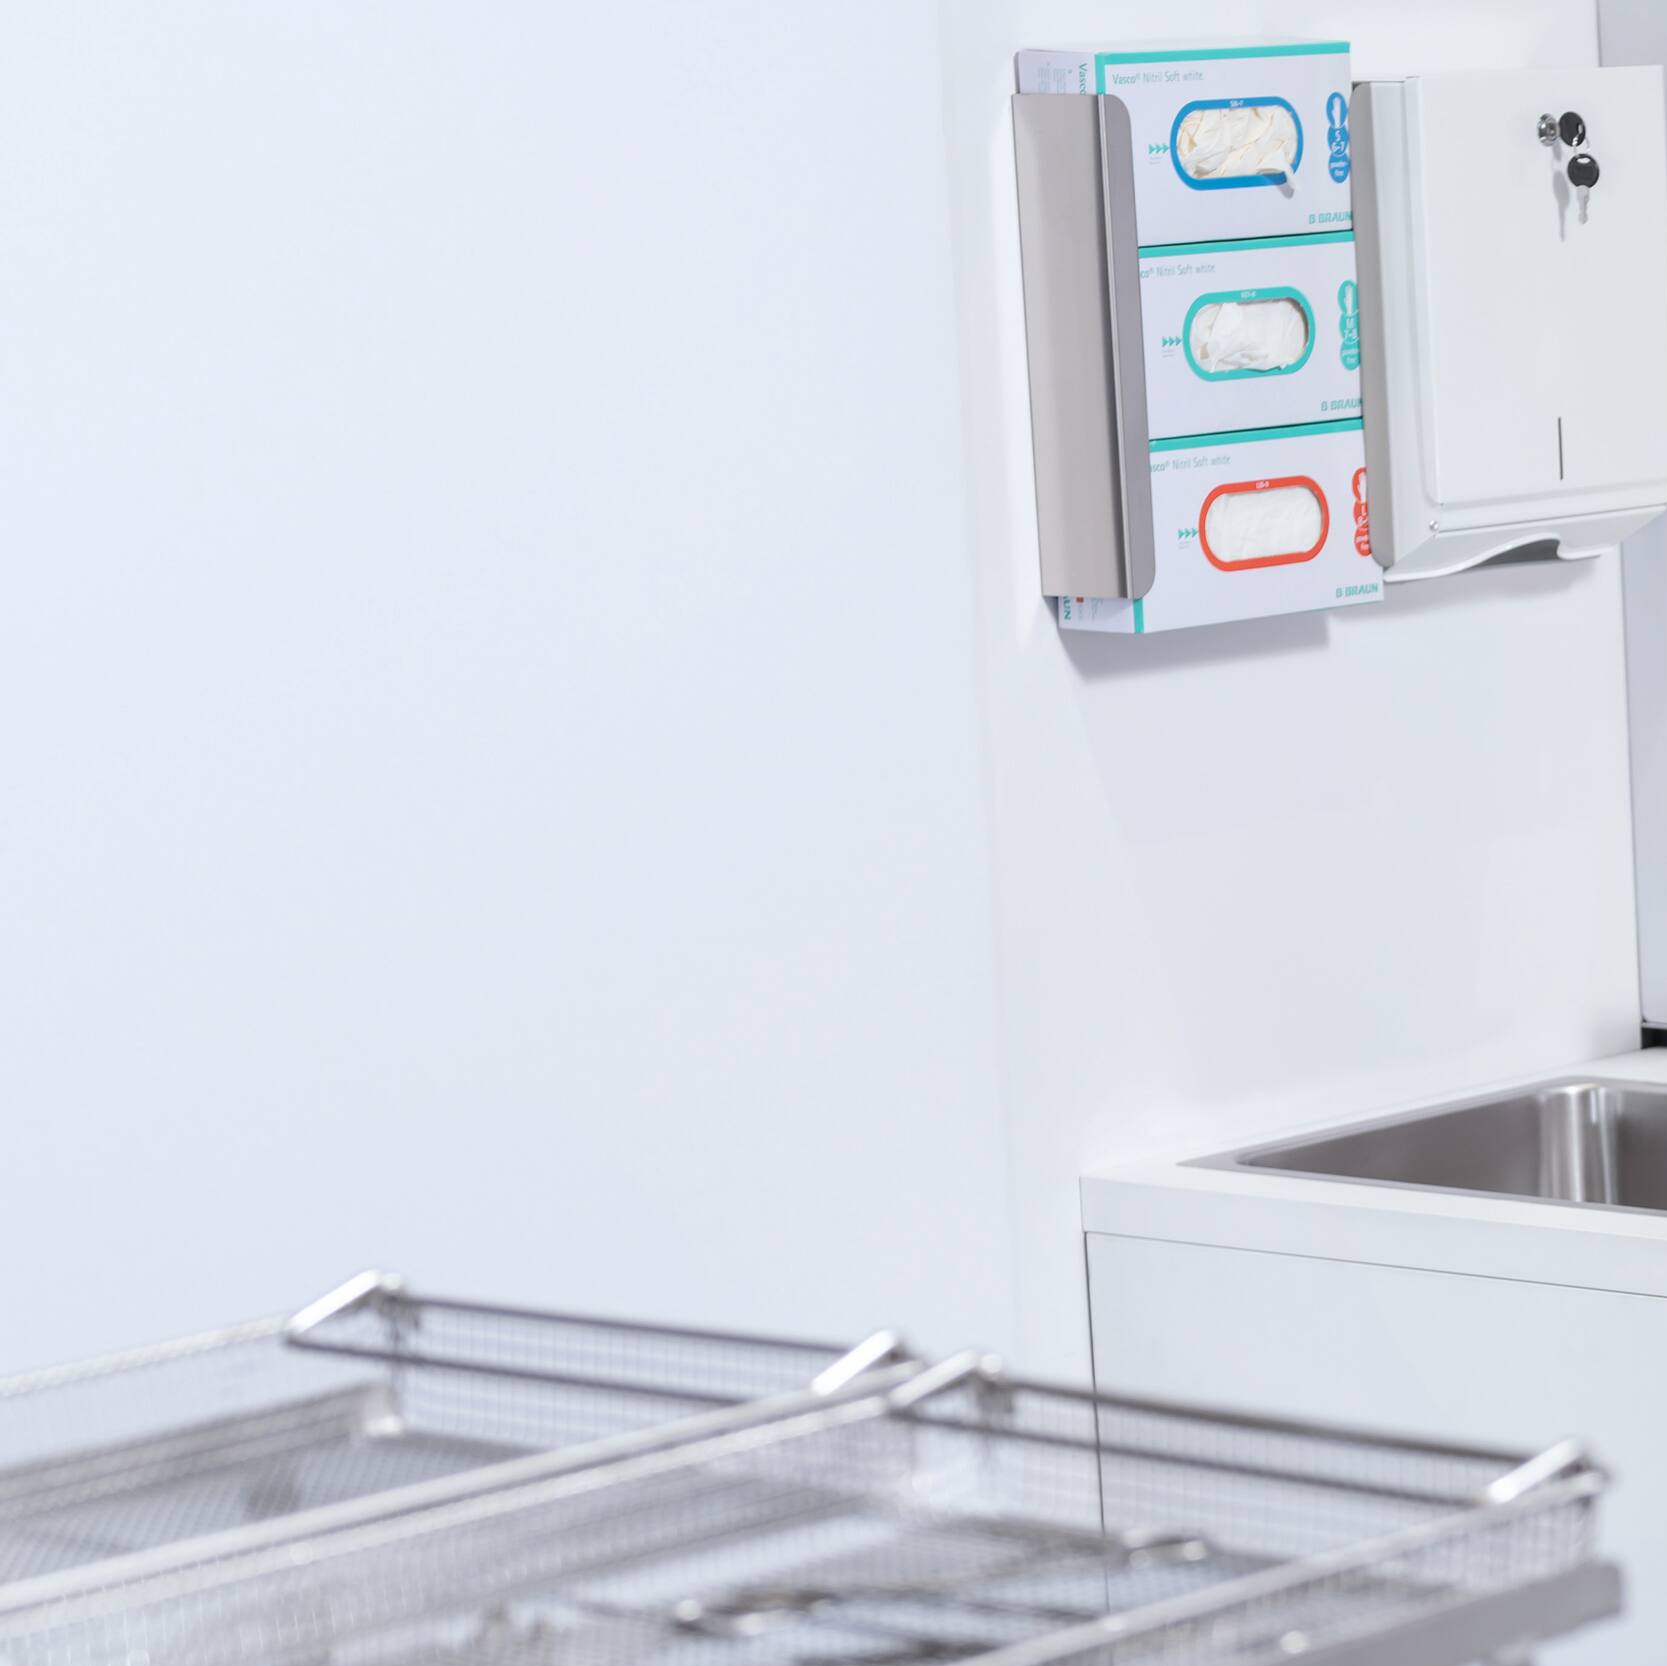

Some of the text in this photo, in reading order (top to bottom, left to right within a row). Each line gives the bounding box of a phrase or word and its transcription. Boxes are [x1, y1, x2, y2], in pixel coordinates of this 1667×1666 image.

[1164, 71, 1180, 82] Soft
[1177, 264, 1193, 275] Soft
[1193, 455, 1209, 467] Soft
[1344, 583, 1378, 597] BRAUN
